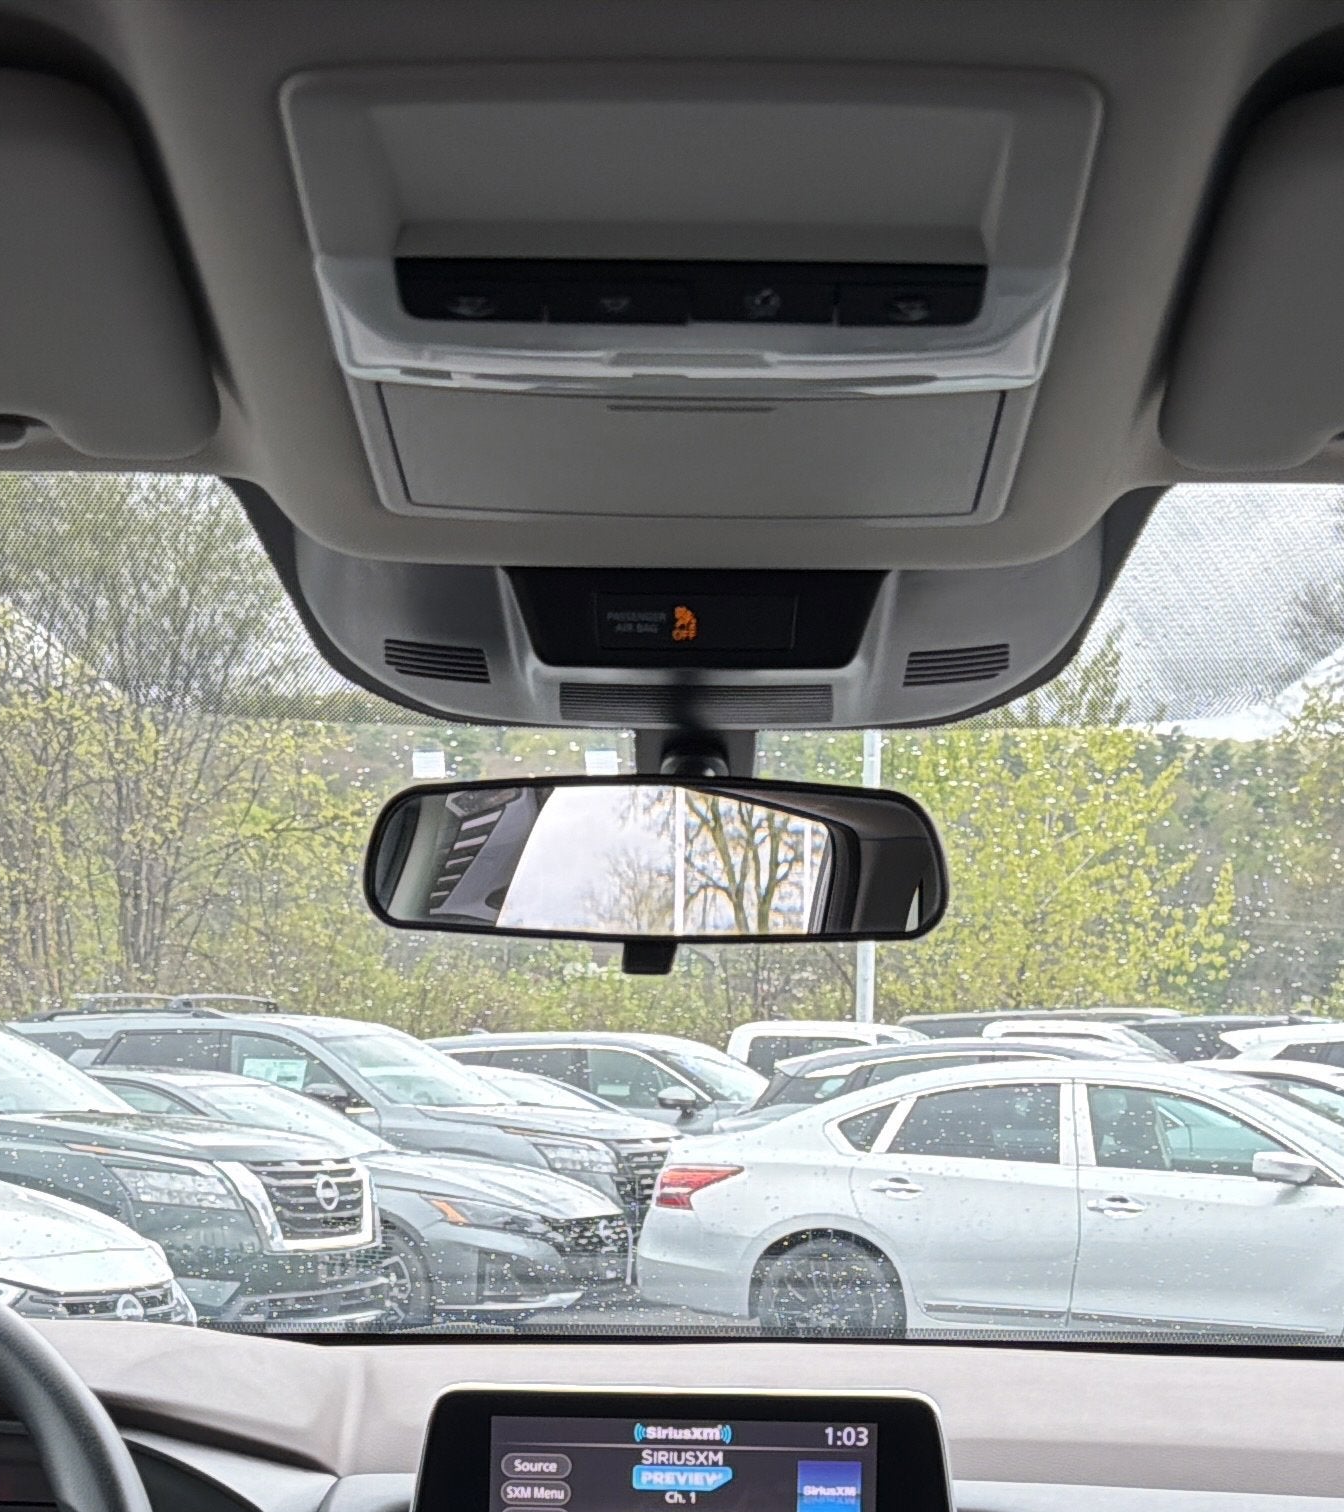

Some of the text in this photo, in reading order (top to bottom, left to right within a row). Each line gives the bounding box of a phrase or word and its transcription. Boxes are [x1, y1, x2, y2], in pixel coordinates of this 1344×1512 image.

[825, 1427, 869, 1446] 1:03
[642, 1450, 723, 1465] SIRIUSXM
[514, 1459, 557, 1473] Source
[641, 1471, 722, 1486] PREVIEW
[506, 1486, 564, 1500] SXM Menu
[665, 1492, 696, 1503] Ch. 1
